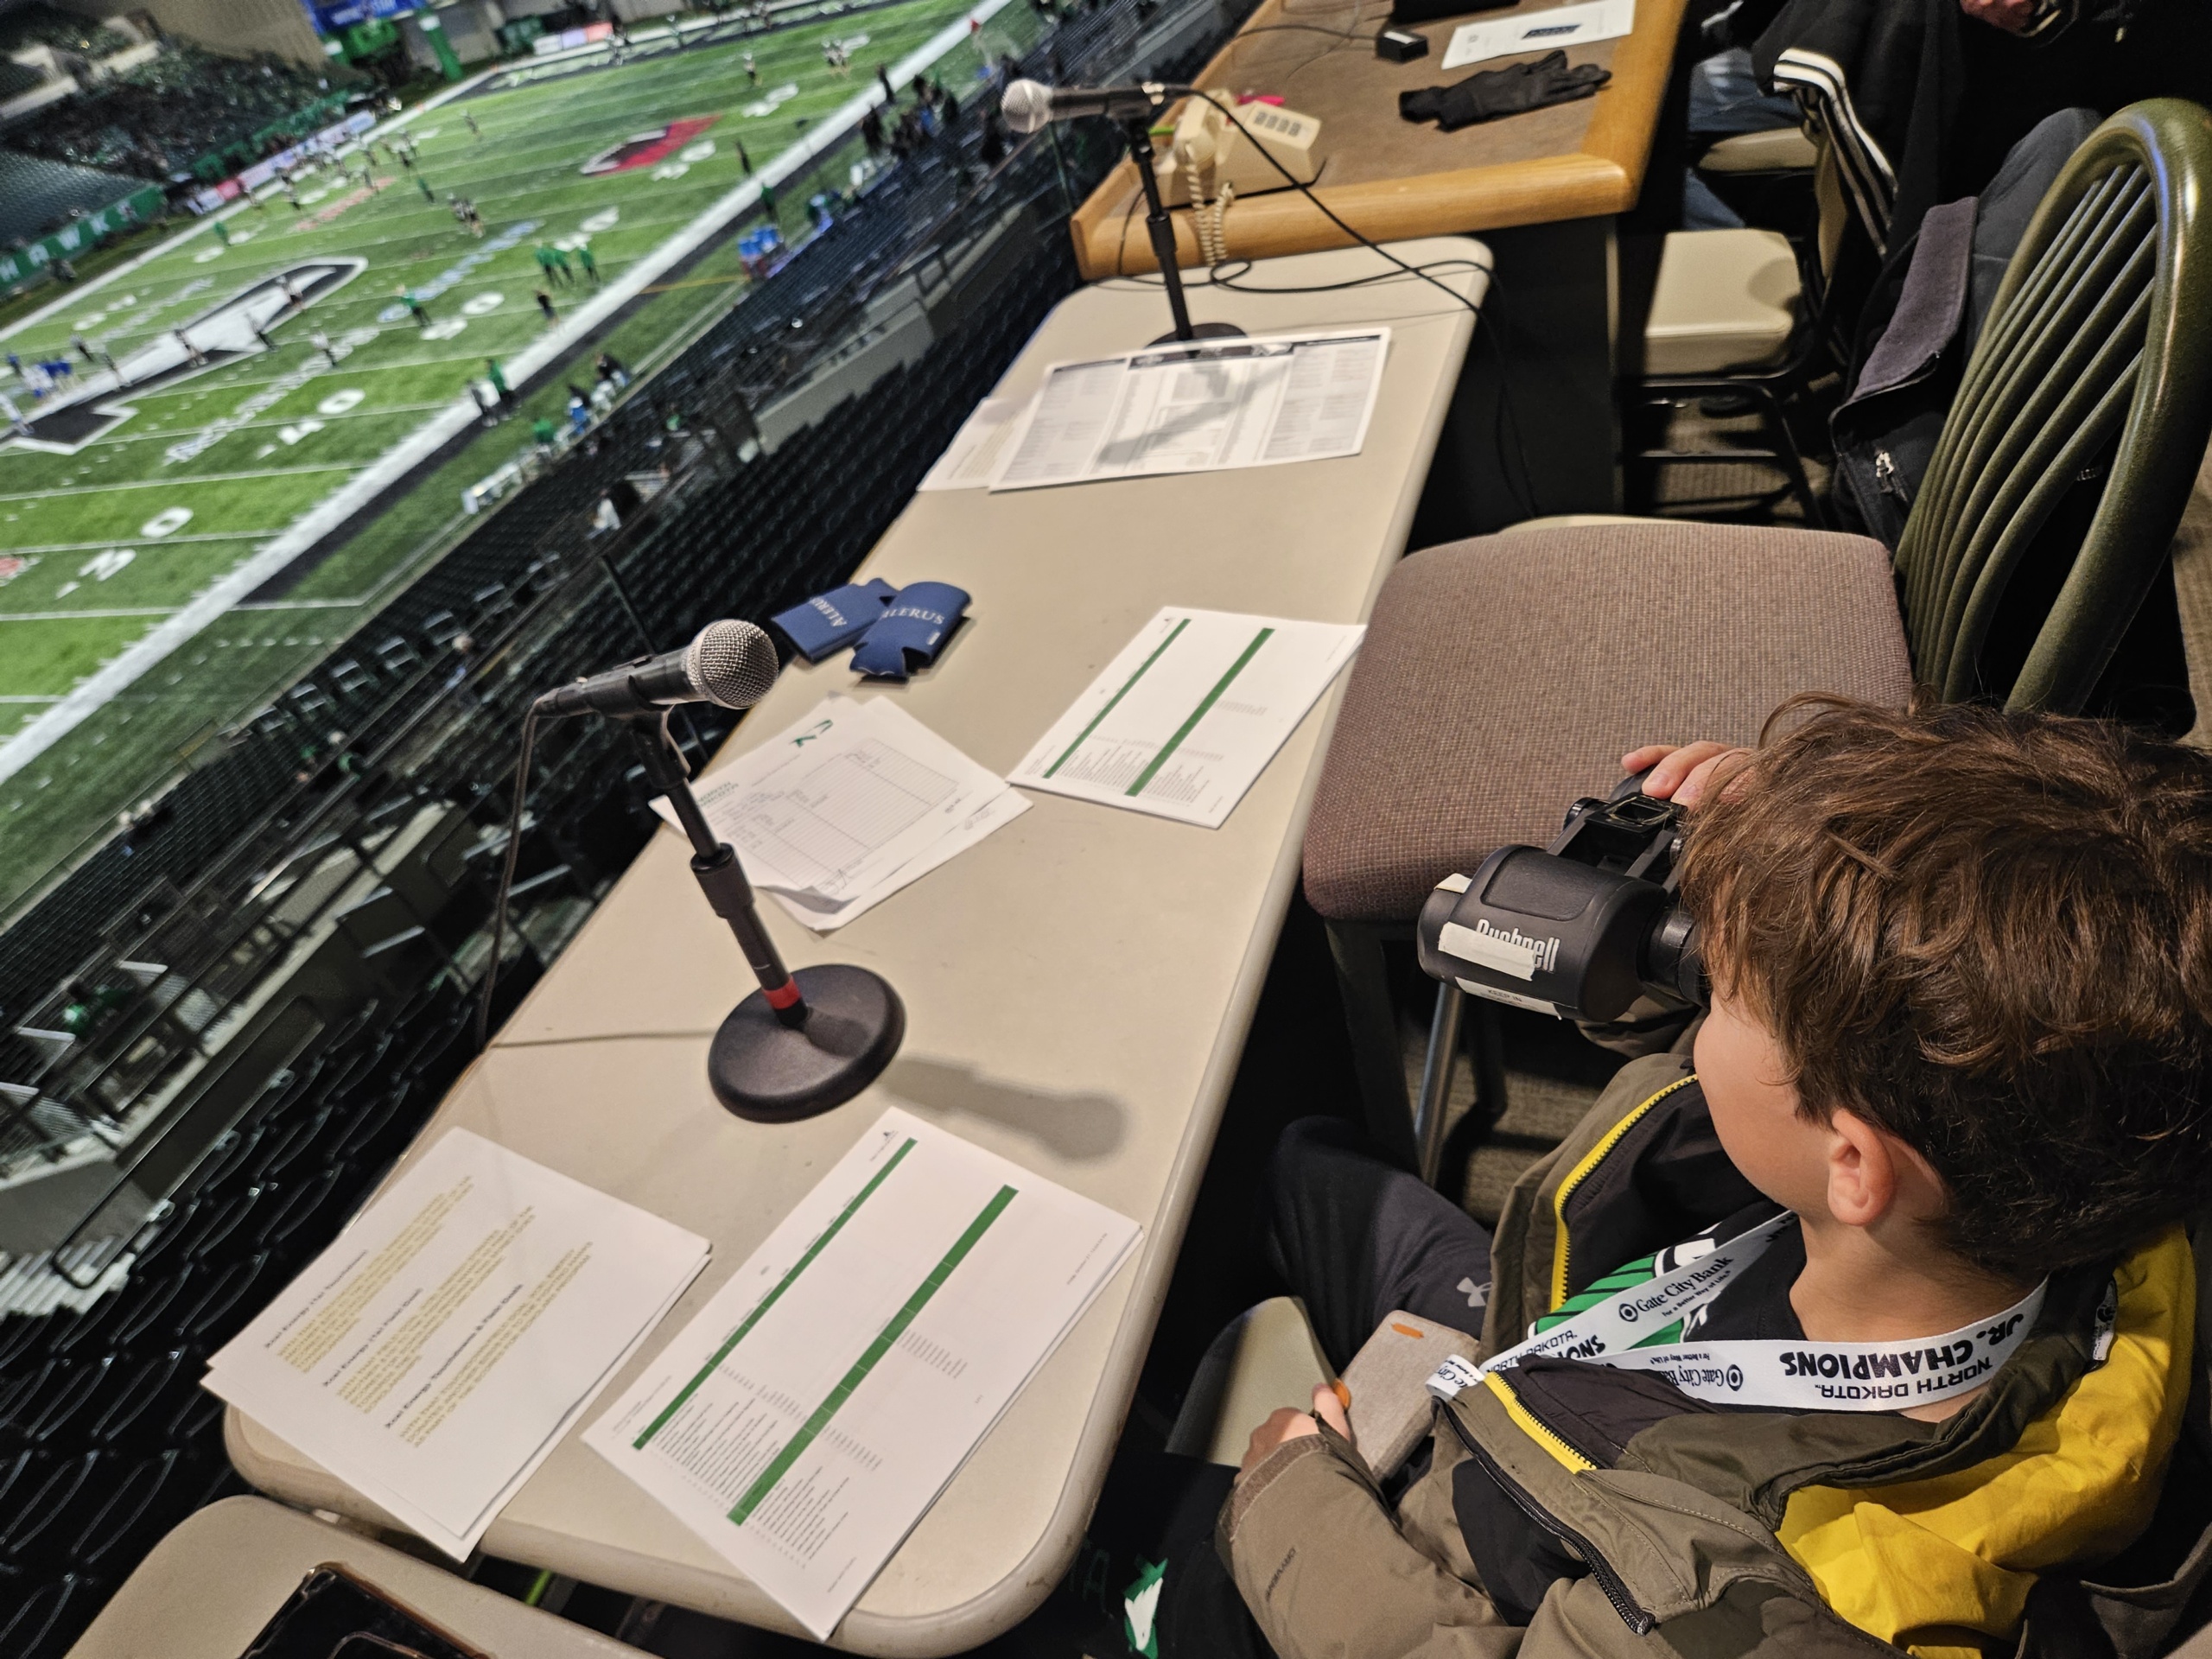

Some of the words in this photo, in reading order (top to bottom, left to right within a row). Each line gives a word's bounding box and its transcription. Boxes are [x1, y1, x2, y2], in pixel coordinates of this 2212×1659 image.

[879, 607, 945, 625] ALERUS
[1636, 1294, 1669, 1312] Gate
[1664, 1279, 1696, 1297] City
[1689, 1256, 1734, 1283] Bank
[1677, 1294, 1695, 1307] Better
[1694, 1287, 1709, 1297] Way
[1708, 1280, 1716, 1288] of
[1976, 1313, 2024, 1346] JR.
[1678, 1364, 1701, 1387] City
[1779, 1341, 1974, 1380] CHAMPIONS
[1702, 1369, 1725, 1387] Gate
[1917, 1357, 1993, 1395] NORTH
